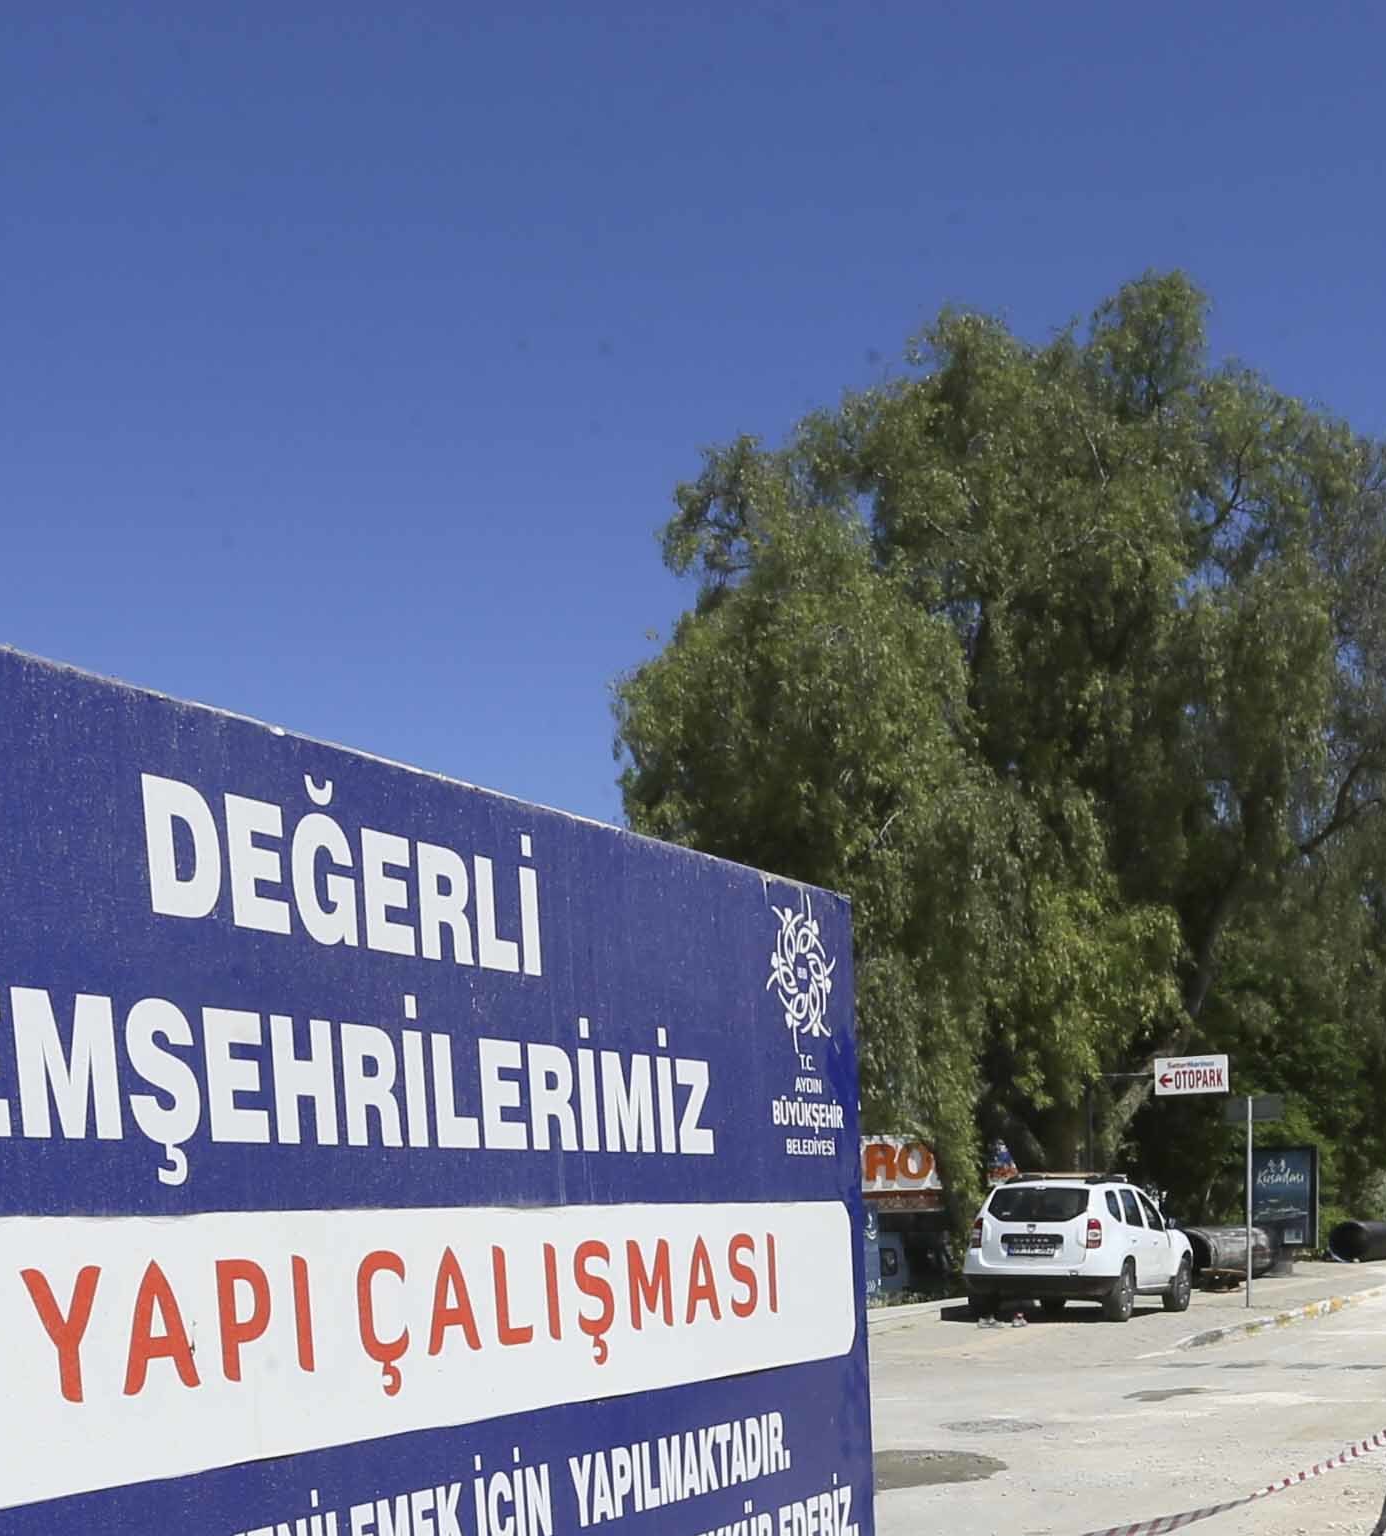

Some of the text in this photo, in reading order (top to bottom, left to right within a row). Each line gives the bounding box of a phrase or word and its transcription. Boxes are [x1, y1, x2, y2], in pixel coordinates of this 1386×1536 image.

[141, 774, 543, 976] DEĞERLİ
[798, 1054, 816, 1072] T.C.
[795, 1077, 822, 1095] AYDIN
[1174, 1069, 1223, 1090] OTOPARK
[772, 1095, 844, 1134] BÜYÜKŞEHİR
[786, 1136, 835, 1156] BELEDİYESİ
[20, 1255, 315, 1403] YAPI
[356, 1232, 779, 1397] ÇALIŞMASI
[569, 1412, 791, 1529] YAPILMAKTADIR.
